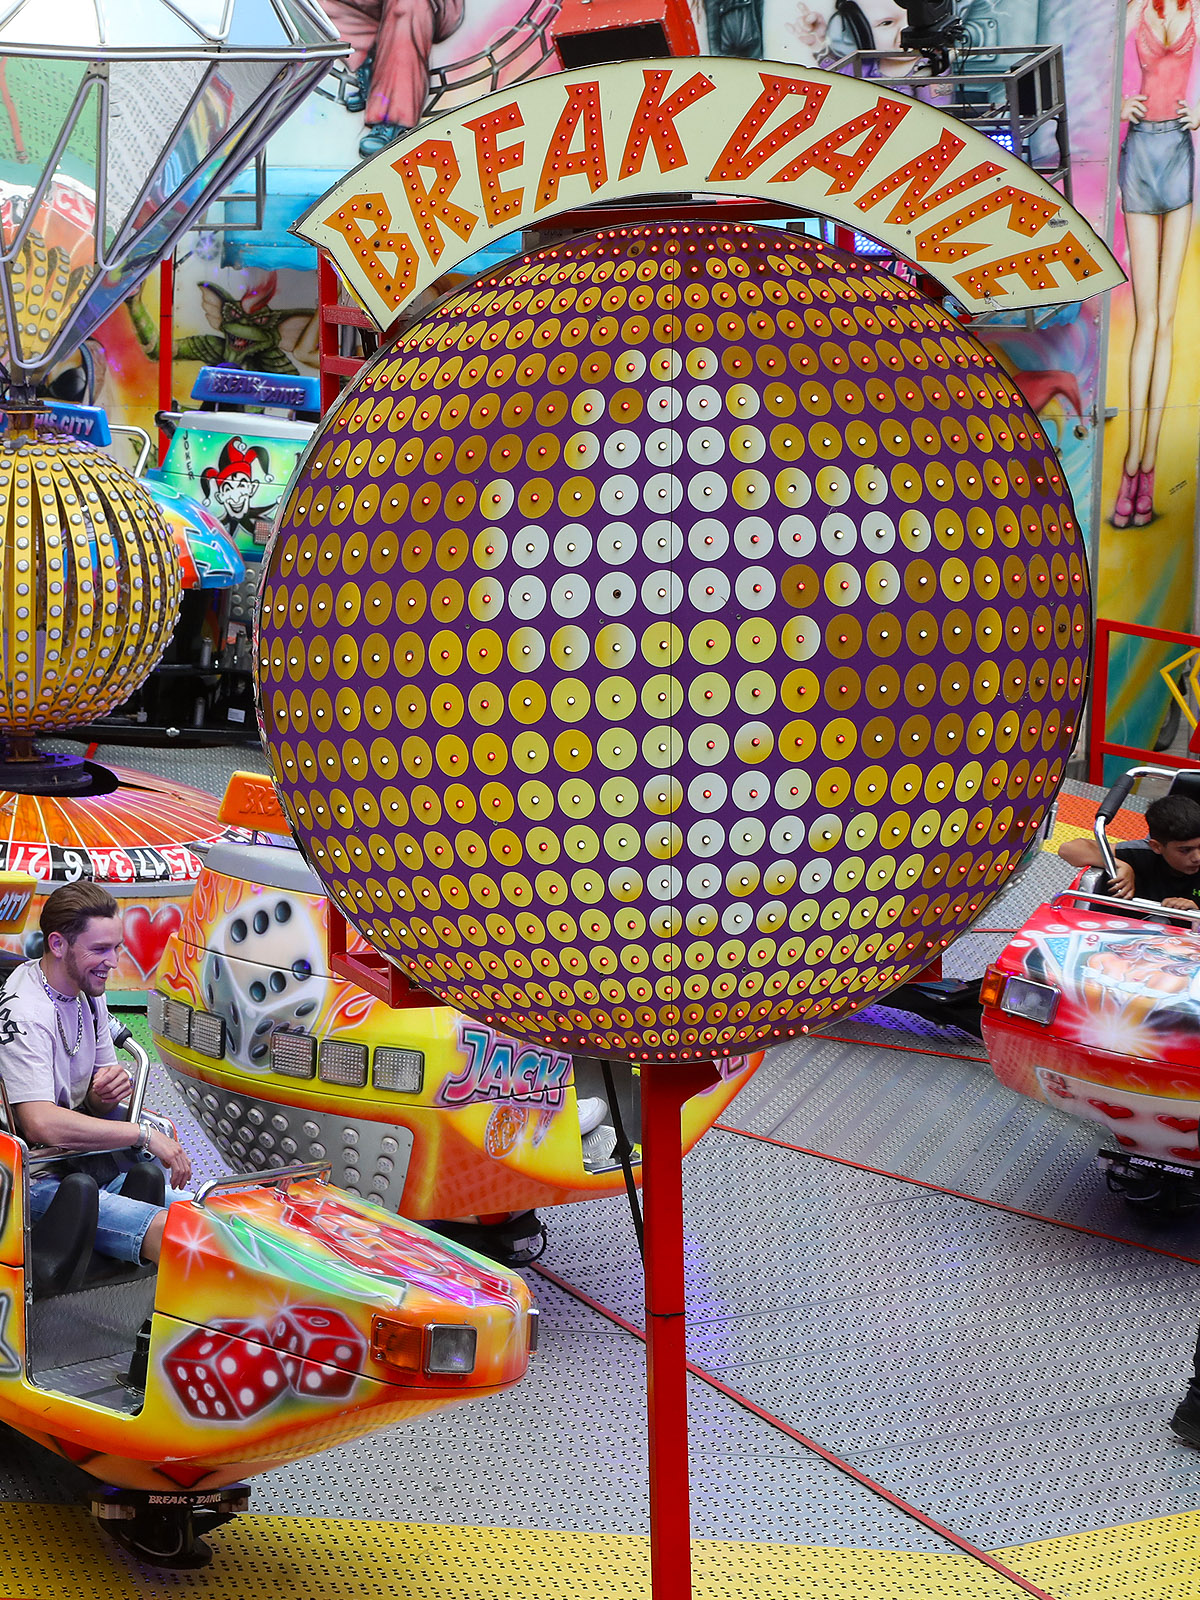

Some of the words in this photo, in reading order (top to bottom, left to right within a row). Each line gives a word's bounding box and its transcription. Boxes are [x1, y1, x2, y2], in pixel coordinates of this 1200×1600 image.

[322, 69, 717, 312] BREAK
[707, 72, 1103, 300] DANCE
[61, 415, 95, 436] CITY
[182, 430, 195, 481] JOKER
[9, 847, 50, 881] 27
[94, 849, 133, 882] 34
[442, 1028, 570, 1107] JACK
[148, 1495, 188, 1505] BREAK
